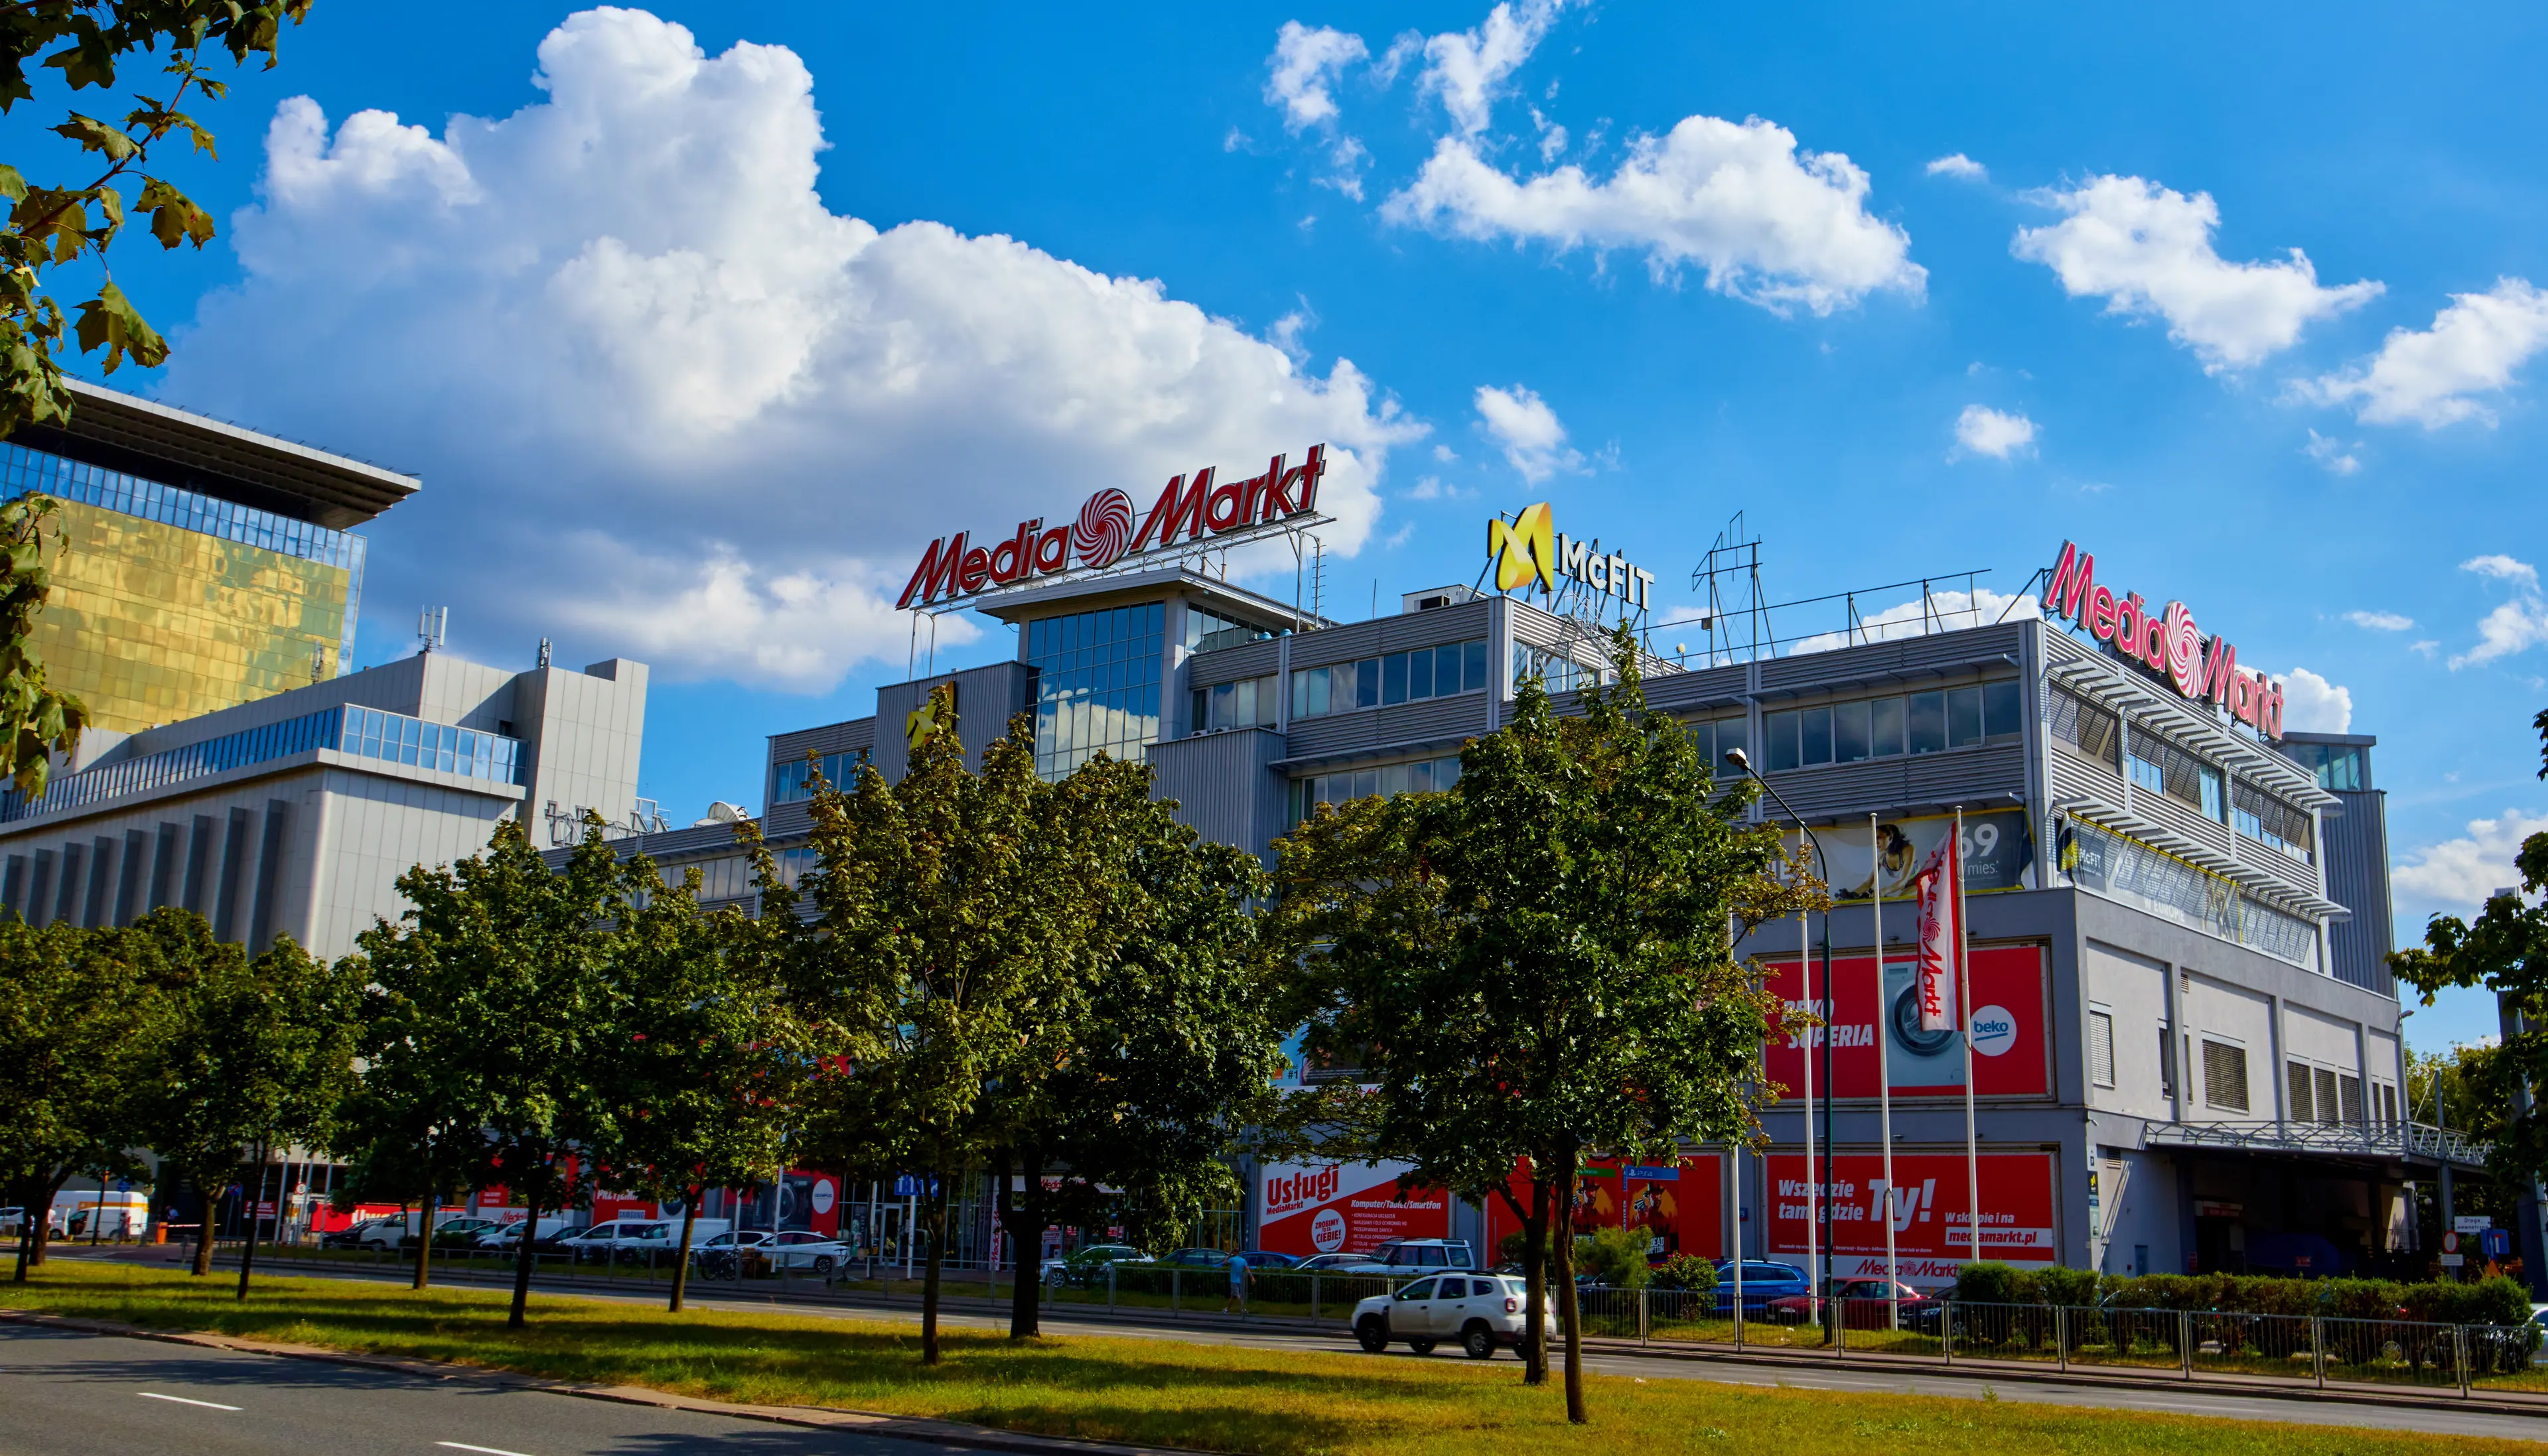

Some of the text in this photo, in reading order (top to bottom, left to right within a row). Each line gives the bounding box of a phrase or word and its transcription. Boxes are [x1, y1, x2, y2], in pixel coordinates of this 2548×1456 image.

[896, 443, 1326, 610] Media Markt
[1559, 533, 1654, 611] McFIT
[2040, 539, 2284, 741] Media Markt
[1922, 938, 1943, 1016] Markt
[1974, 1020, 2009, 1033] beko
[1268, 1164, 1340, 1206] Usługi
[1267, 1201, 1304, 1215] MediaMarkt
[1868, 1178, 1936, 1232] Ty!
[1315, 1219, 1339, 1229] ZROBIMY
[1946, 1212, 1955, 1223] W
[1995, 1213, 1999, 1223] i
[2001, 1214, 2015, 1224] na
[1316, 1230, 1341, 1243] CIEBIE!
[1949, 1231, 2037, 1245] medamarkt.pl
[1855, 1259, 1904, 1276] Meda
